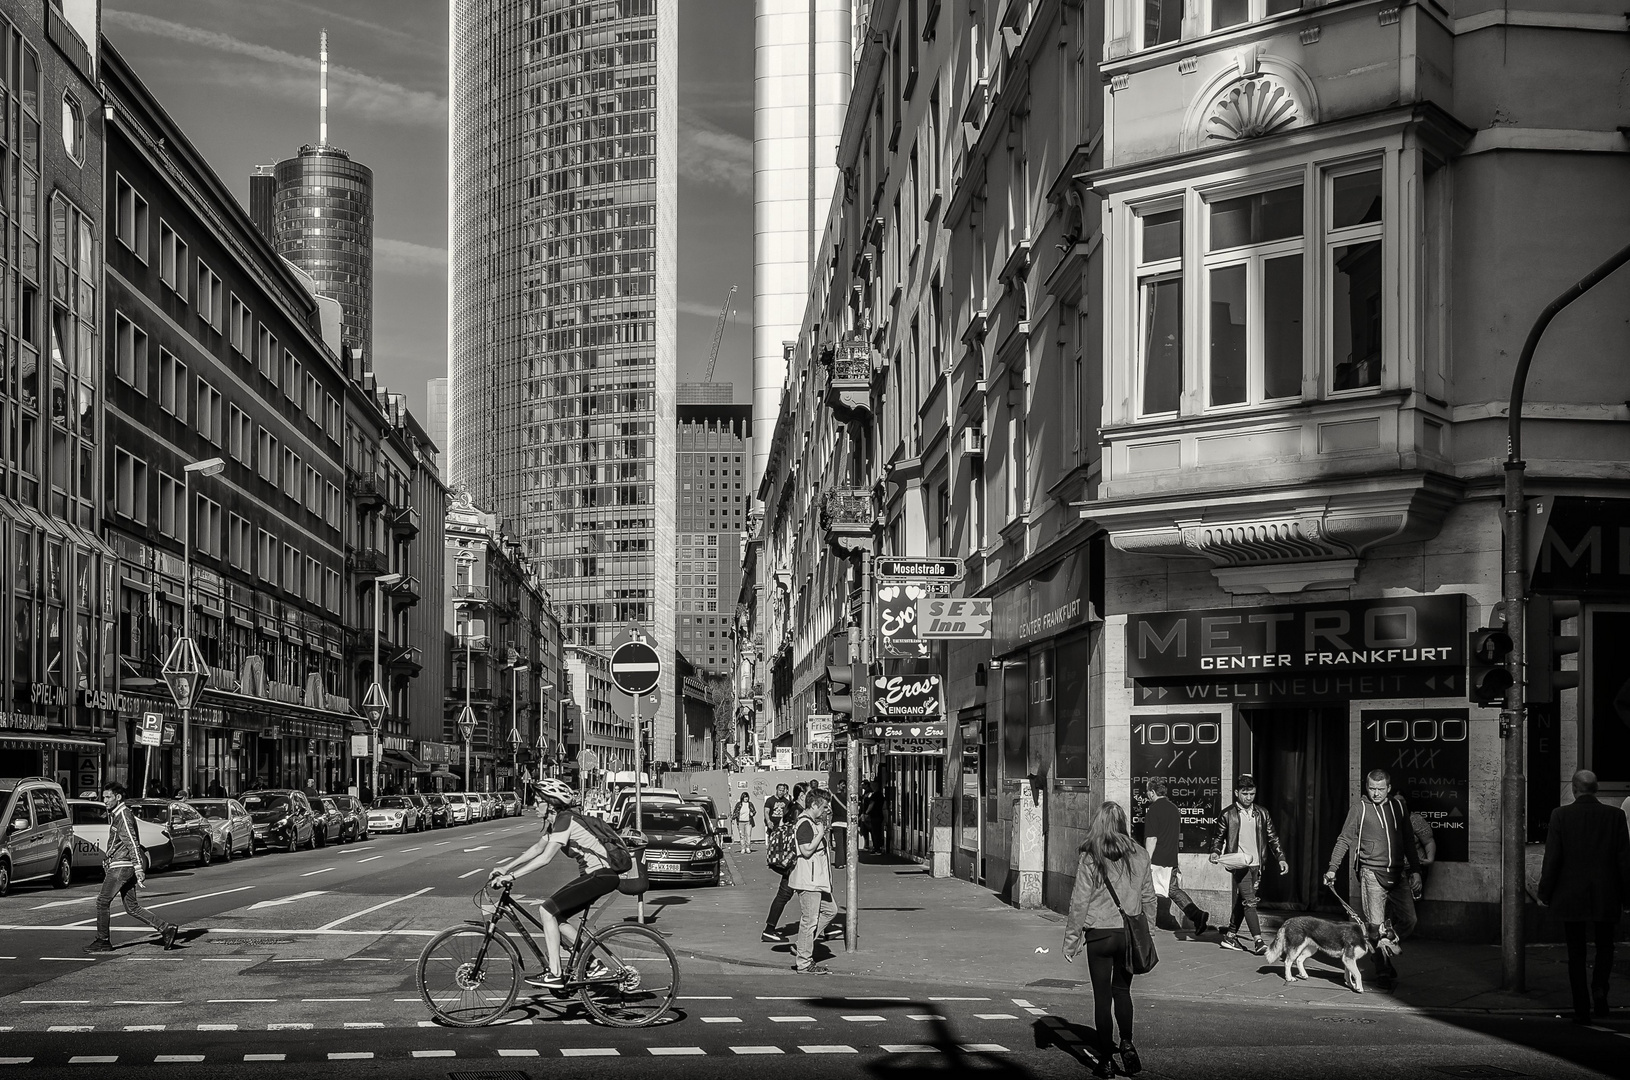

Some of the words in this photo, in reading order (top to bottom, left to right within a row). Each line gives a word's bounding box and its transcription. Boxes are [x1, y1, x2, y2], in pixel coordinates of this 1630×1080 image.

[1541, 525, 1630, 574] M
[893, 564, 945, 576] Moselstraße
[929, 601, 992, 617] SEX
[881, 604, 917, 636] Ero
[929, 618, 968, 632] Inn
[1019, 618, 1042, 639] CENTER
[1042, 598, 1081, 630] FRANKFURT
[1138, 606, 1417, 660] METRO
[1200, 653, 1292, 670] CENTER
[1304, 646, 1453, 666] FRANKFURT
[886, 676, 933, 704] Eros
[1185, 675, 1407, 699] WELTNEUHEIT
[84, 689, 124, 712] CASINO
[888, 706, 924, 715] EINGANG
[146, 715, 157, 729] P
[1366, 718, 1467, 742] 1000
[885, 726, 903, 737] Eros
[924, 726, 945, 736] Eros
[1133, 722, 1220, 745] 1000
[910, 745, 924, 753] 39
[1408, 777, 1464, 786] RAMME
[1171, 788, 1218, 797] SCHRF
[1411, 790, 1458, 799] SCHR
[1429, 821, 1464, 829] CHNIK
